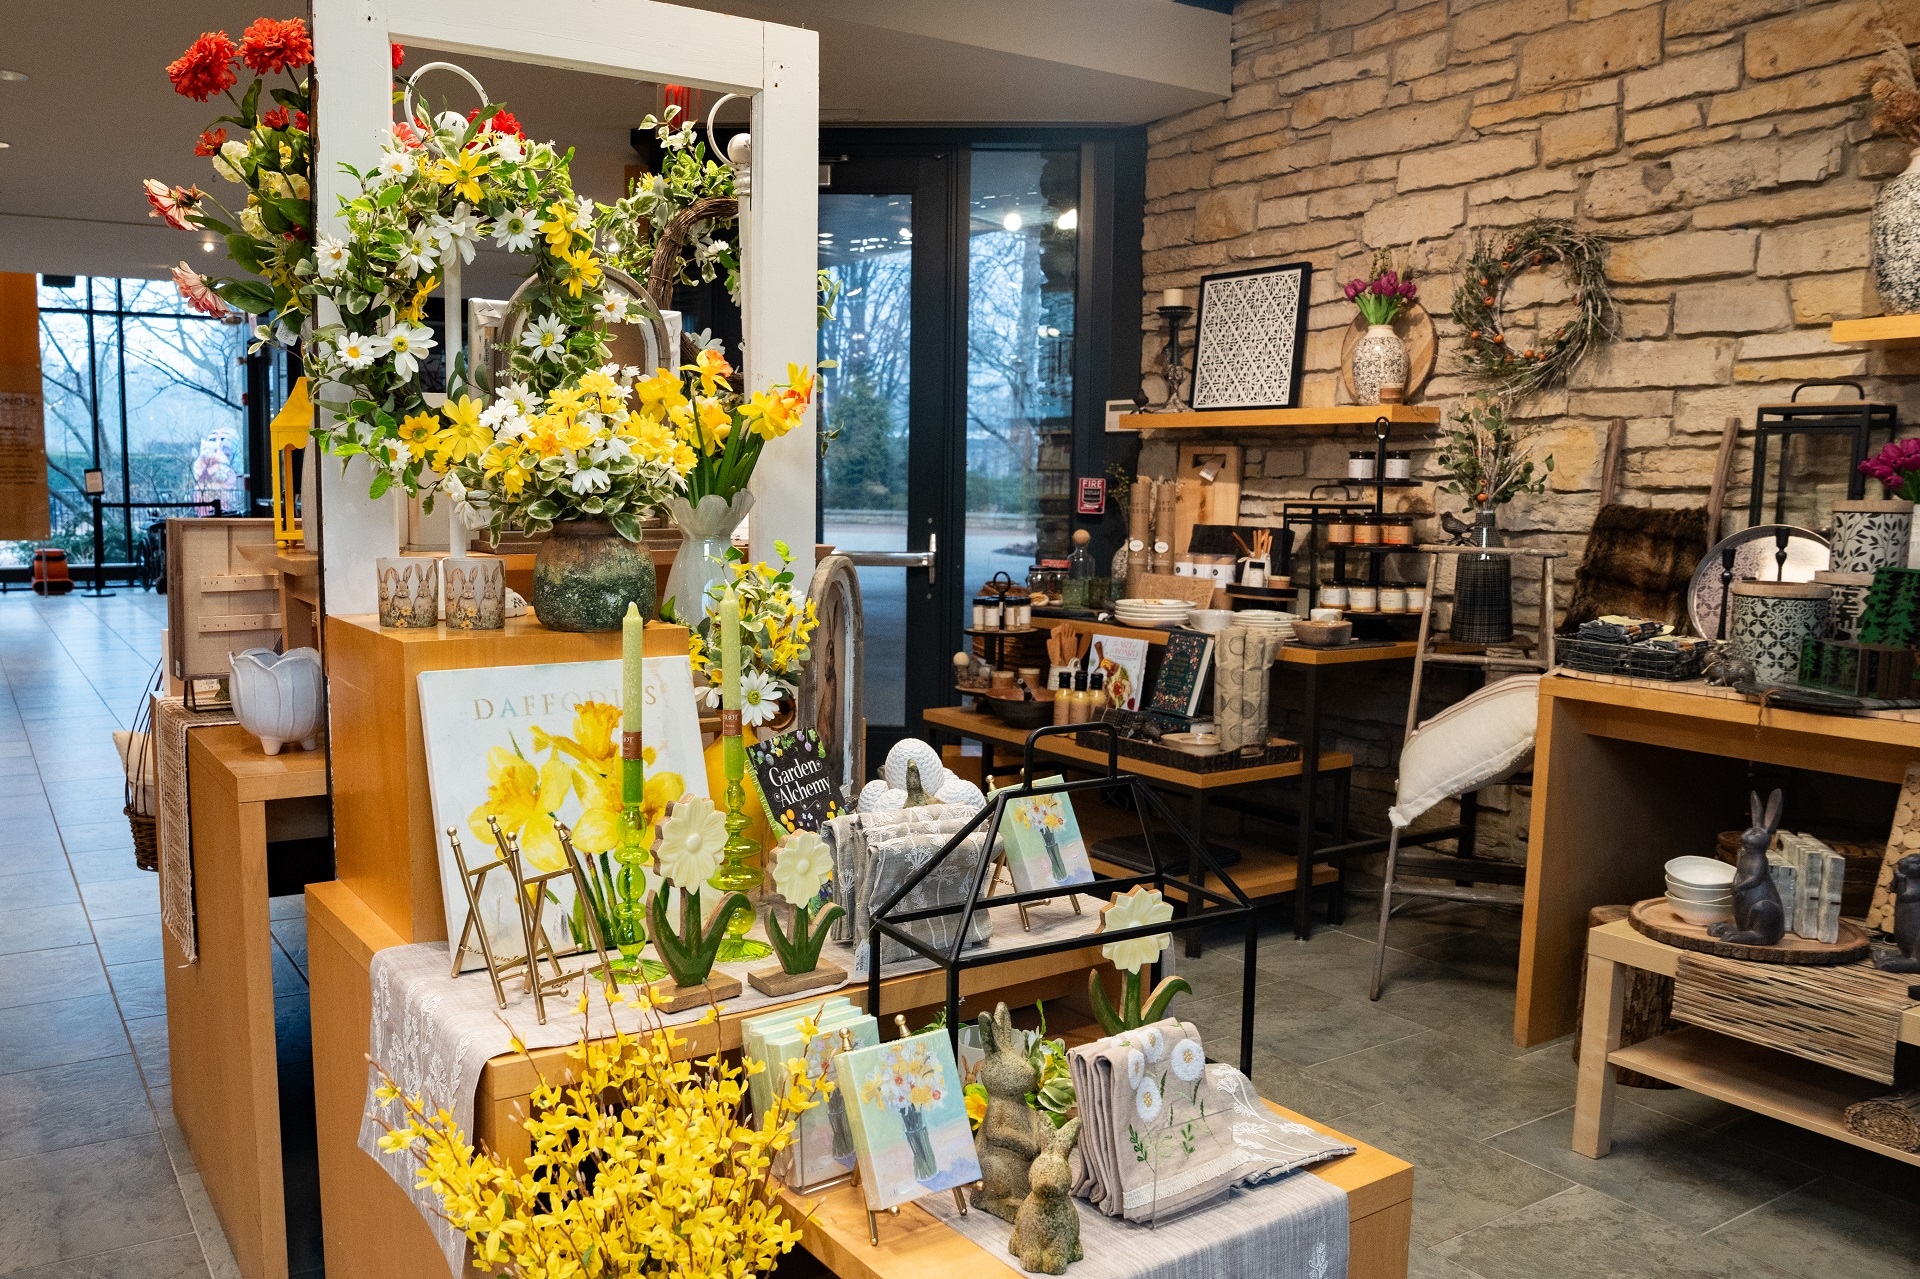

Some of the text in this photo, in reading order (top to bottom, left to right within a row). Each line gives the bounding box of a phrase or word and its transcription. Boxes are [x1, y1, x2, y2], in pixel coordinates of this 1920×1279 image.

[1083, 480, 1103, 488] FIRE
[474, 684, 657, 721] DAFFODIS
[768, 759, 822, 788] Garden
[744, 760, 778, 831] GARDEN ALCHEMY
[773, 776, 832, 808] Alchemy
